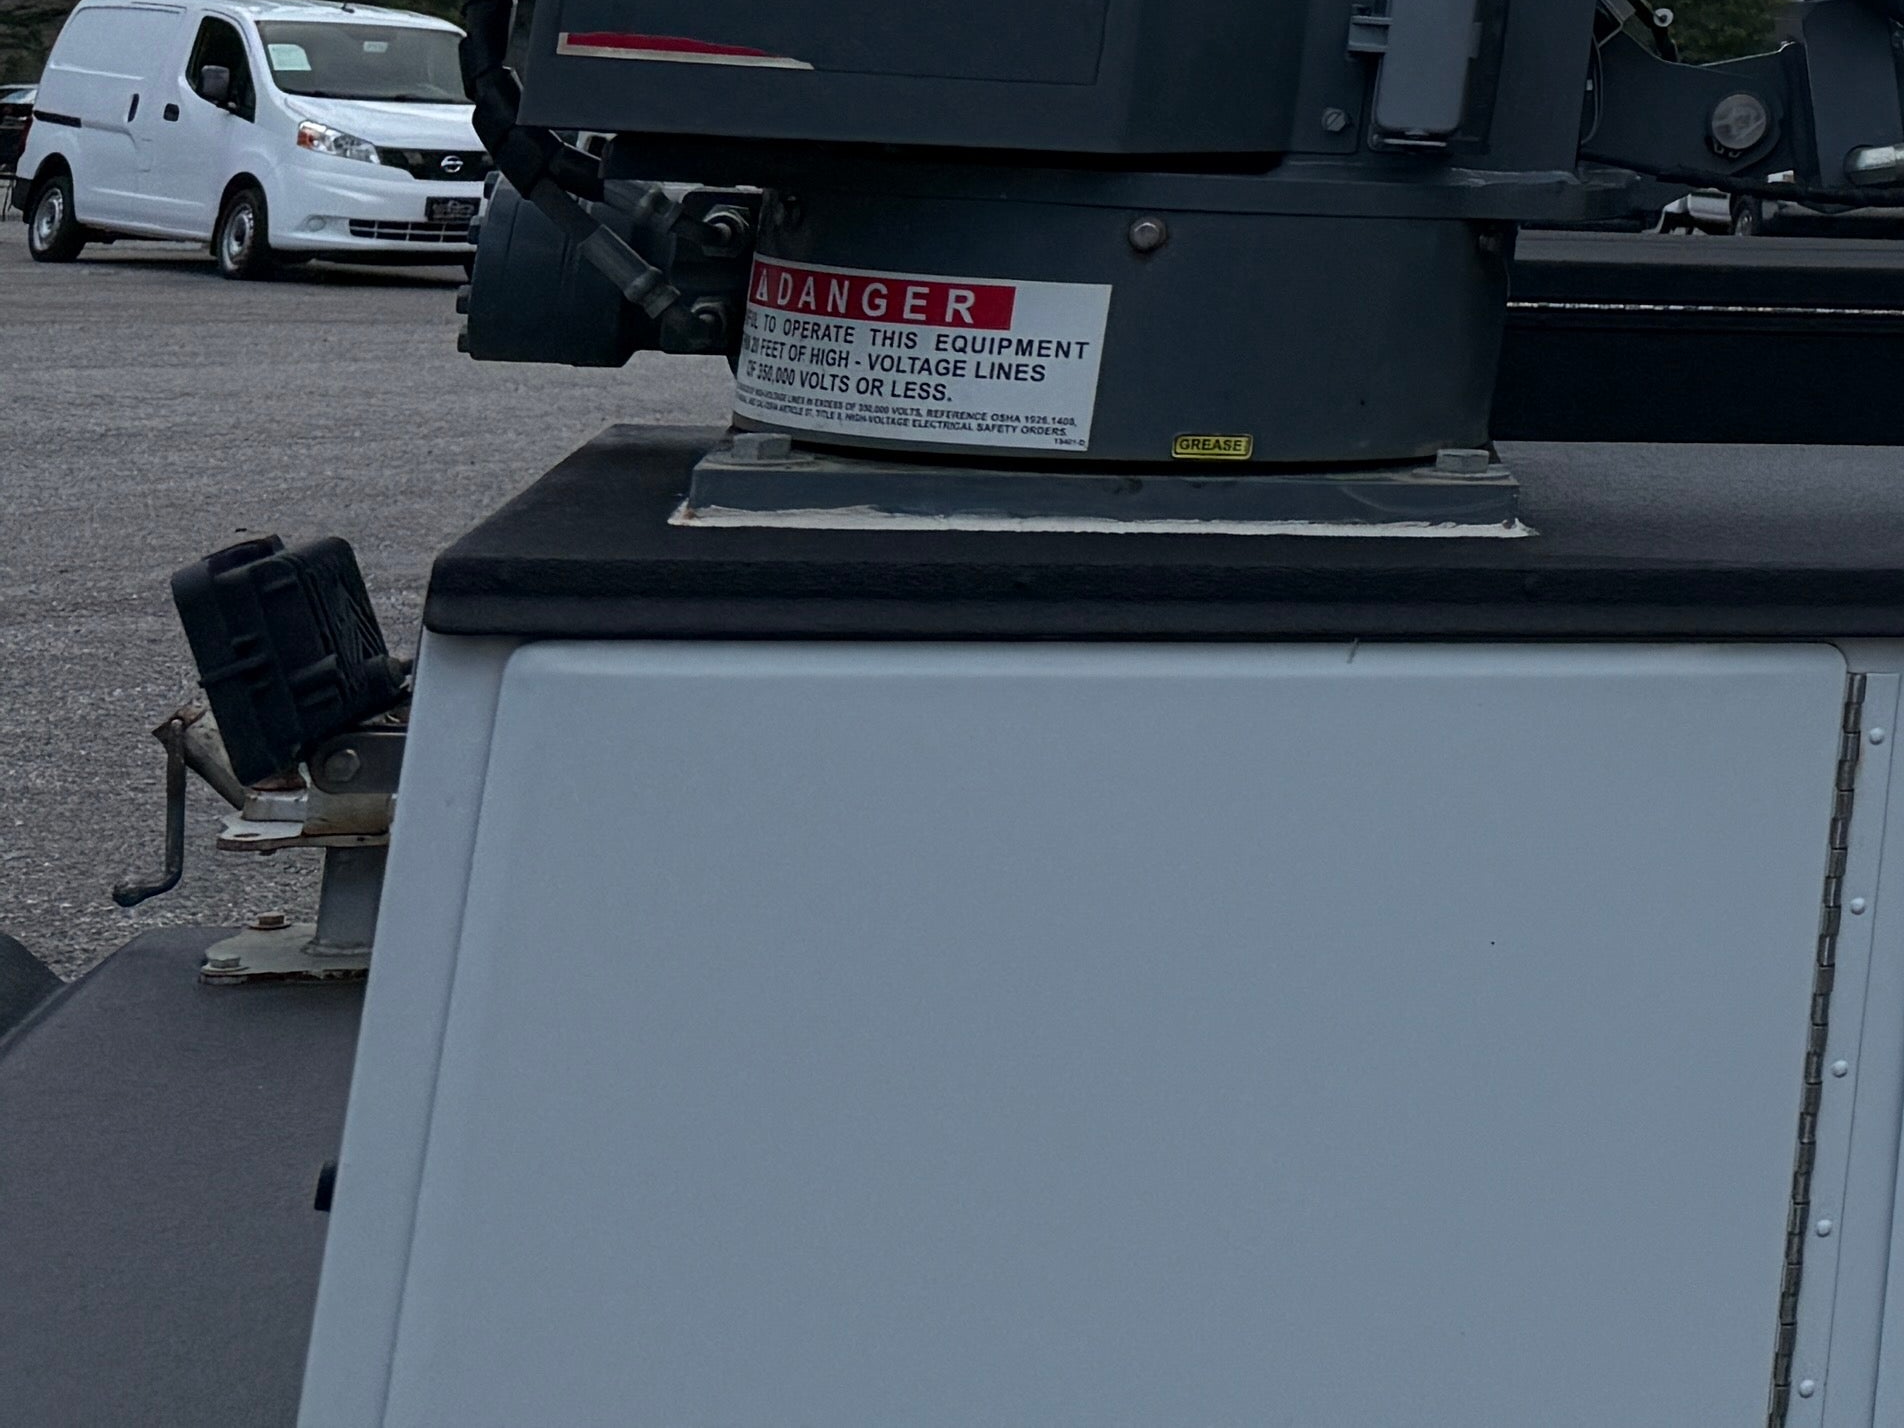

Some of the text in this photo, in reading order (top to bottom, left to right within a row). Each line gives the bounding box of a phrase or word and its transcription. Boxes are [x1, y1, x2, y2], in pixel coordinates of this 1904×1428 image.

[777, 271, 975, 325] DANGER
[764, 313, 777, 333] TO
[783, 318, 855, 344] OPERATE
[870, 328, 918, 350] THIS
[934, 334, 1090, 360] EQUIPMENT
[760, 338, 786, 359] FEET
[788, 343, 807, 363] OF
[809, 345, 850, 369] HIGH
[868, 354, 967, 378] VOLTAGE
[975, 361, 1046, 383] LINES
[799, 371, 850, 394] VOLTS
[856, 376, 884, 397] OR
[891, 379, 952, 403] LESS.
[912, 418, 974, 432] ELECTRICAL
[976, 423, 1018, 434] SAFETY
[926, 409, 987, 422] REFERENCE
[991, 413, 1021, 424] OSHA
[1179, 438, 1242, 452] GREASE
